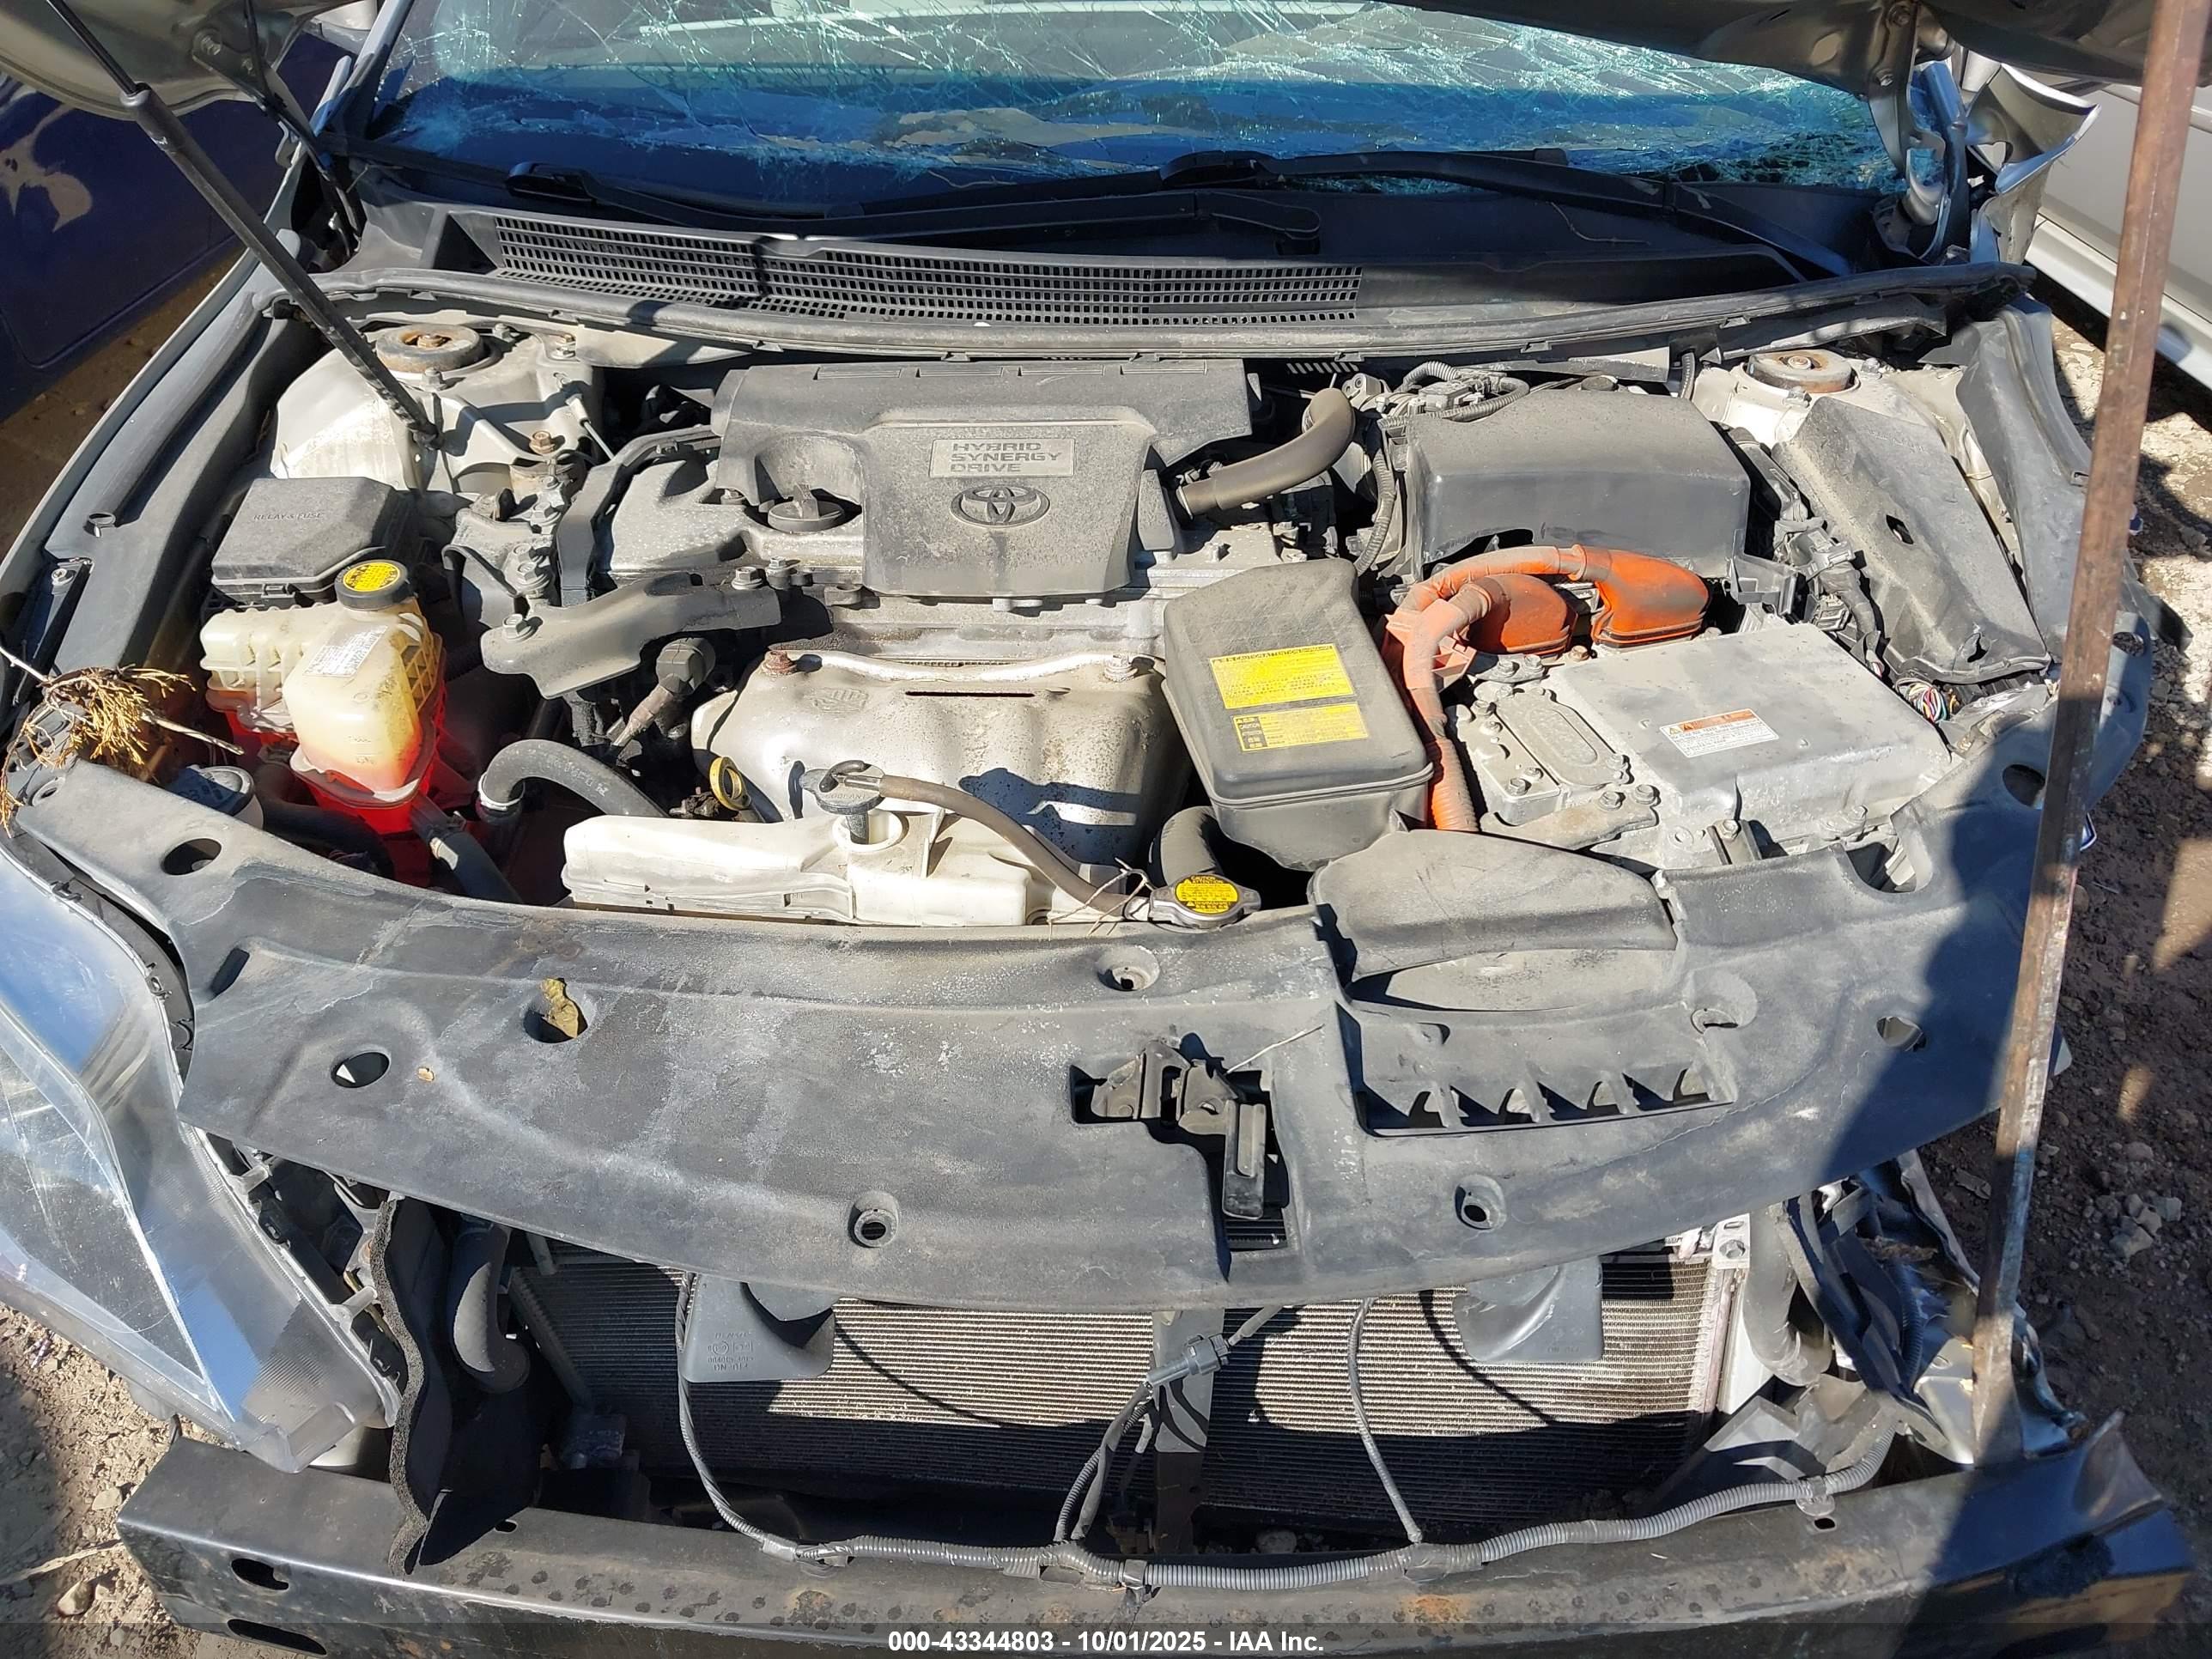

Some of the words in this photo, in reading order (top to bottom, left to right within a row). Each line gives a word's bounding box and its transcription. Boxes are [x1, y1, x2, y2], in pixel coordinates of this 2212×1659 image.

[952, 442, 1042, 451] HYBRID
[951, 452, 1062, 461] SYNERGY
[950, 463, 1022, 472] DRIVE
